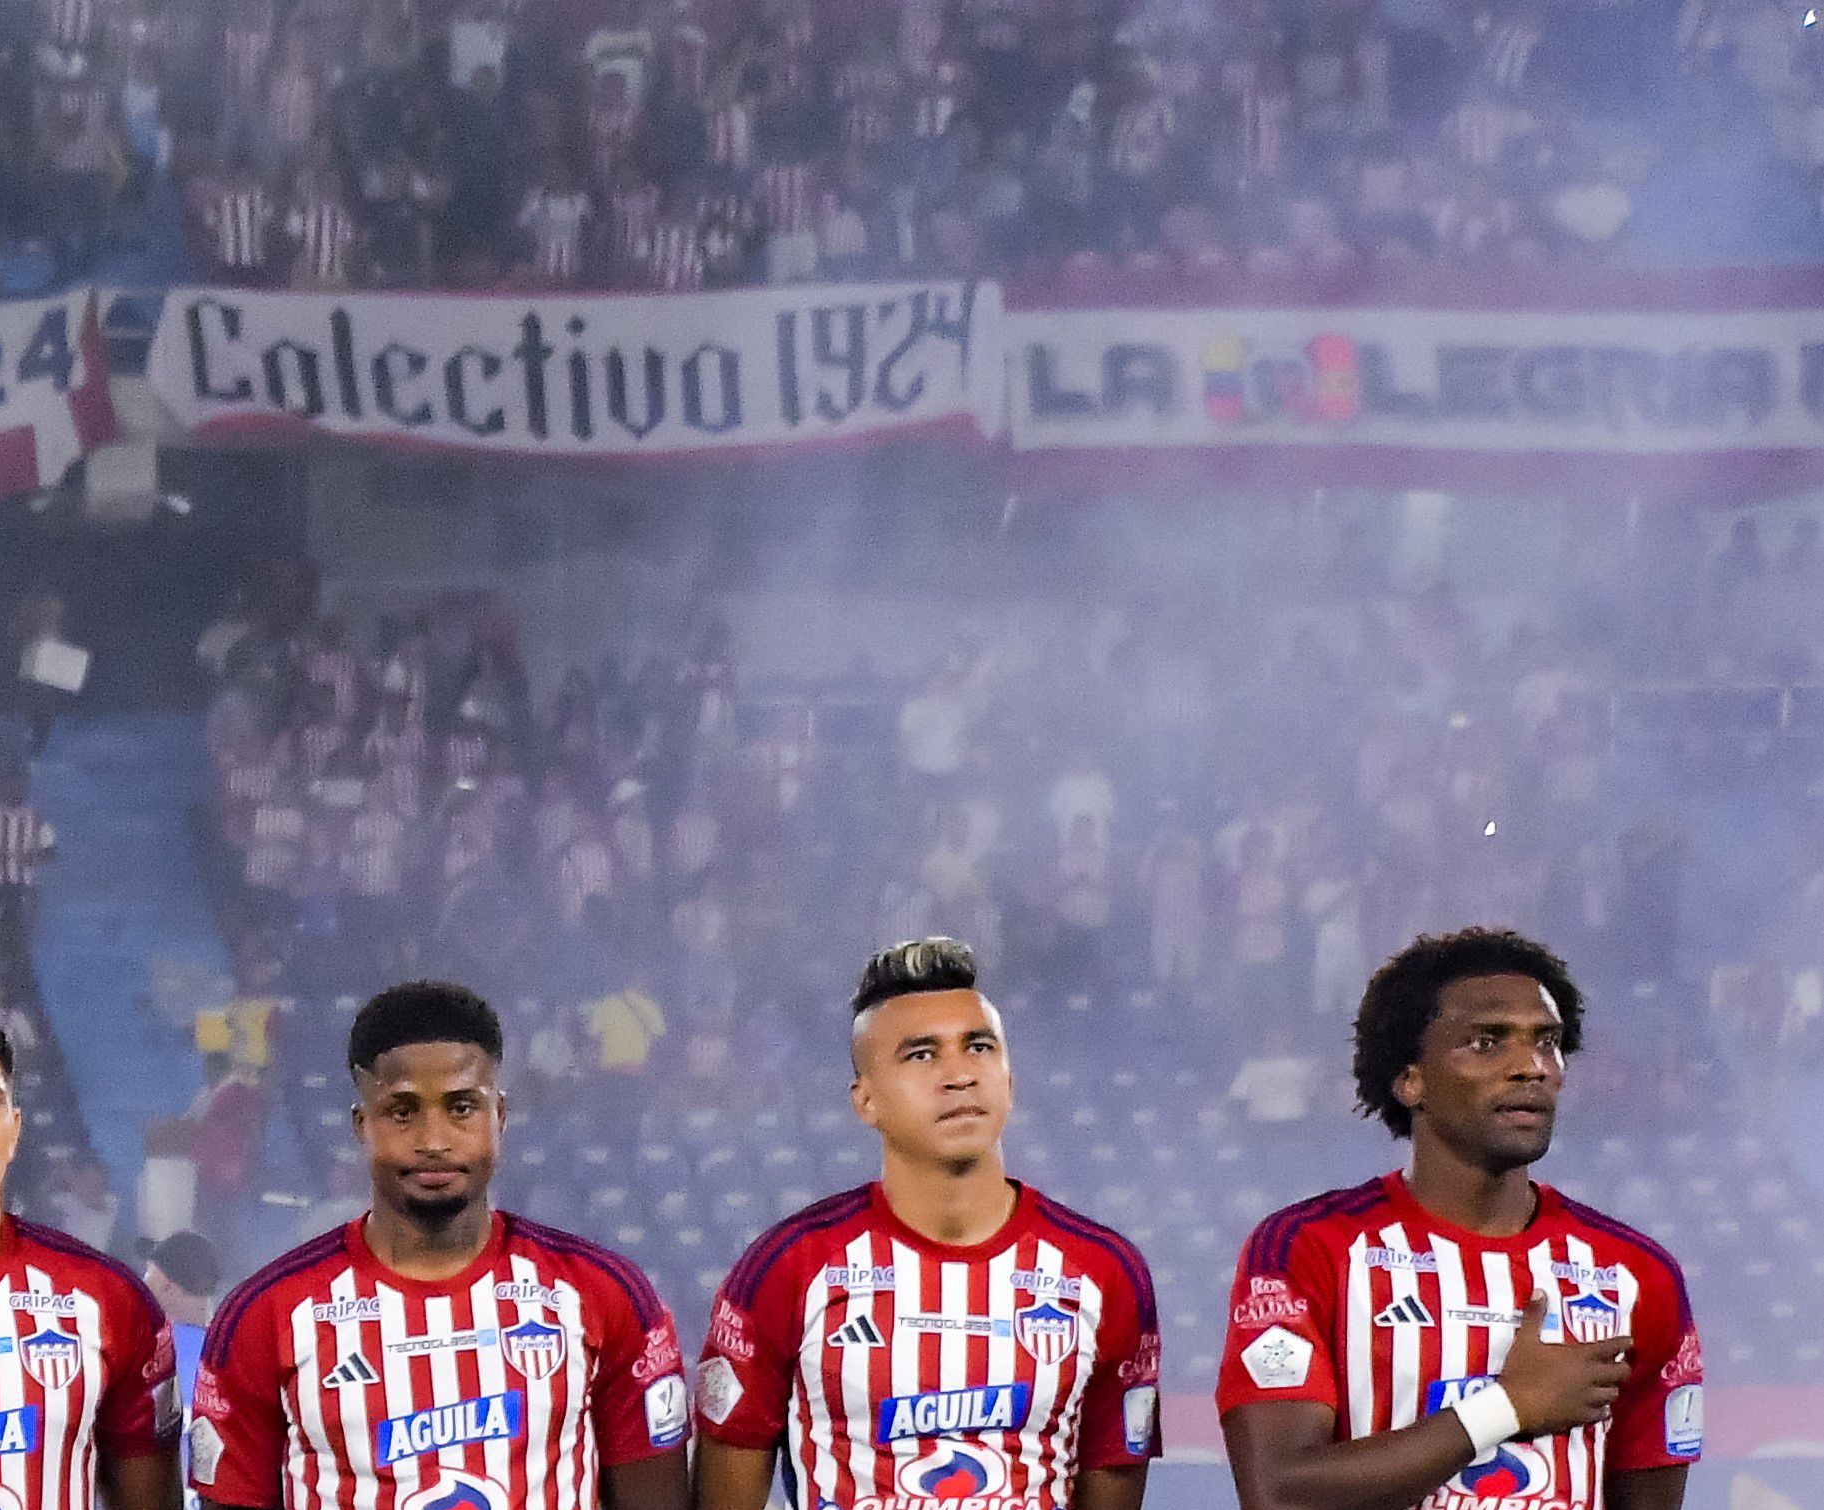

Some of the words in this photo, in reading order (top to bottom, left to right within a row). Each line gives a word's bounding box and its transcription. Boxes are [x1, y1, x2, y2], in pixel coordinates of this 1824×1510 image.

[183, 297, 743, 443] Colectivo
[775, 284, 974, 427] 1924
[1028, 342, 1187, 420] LA
[384, 1396, 511, 1464] AGUILA
[890, 1388, 1014, 1441] AGUILA
